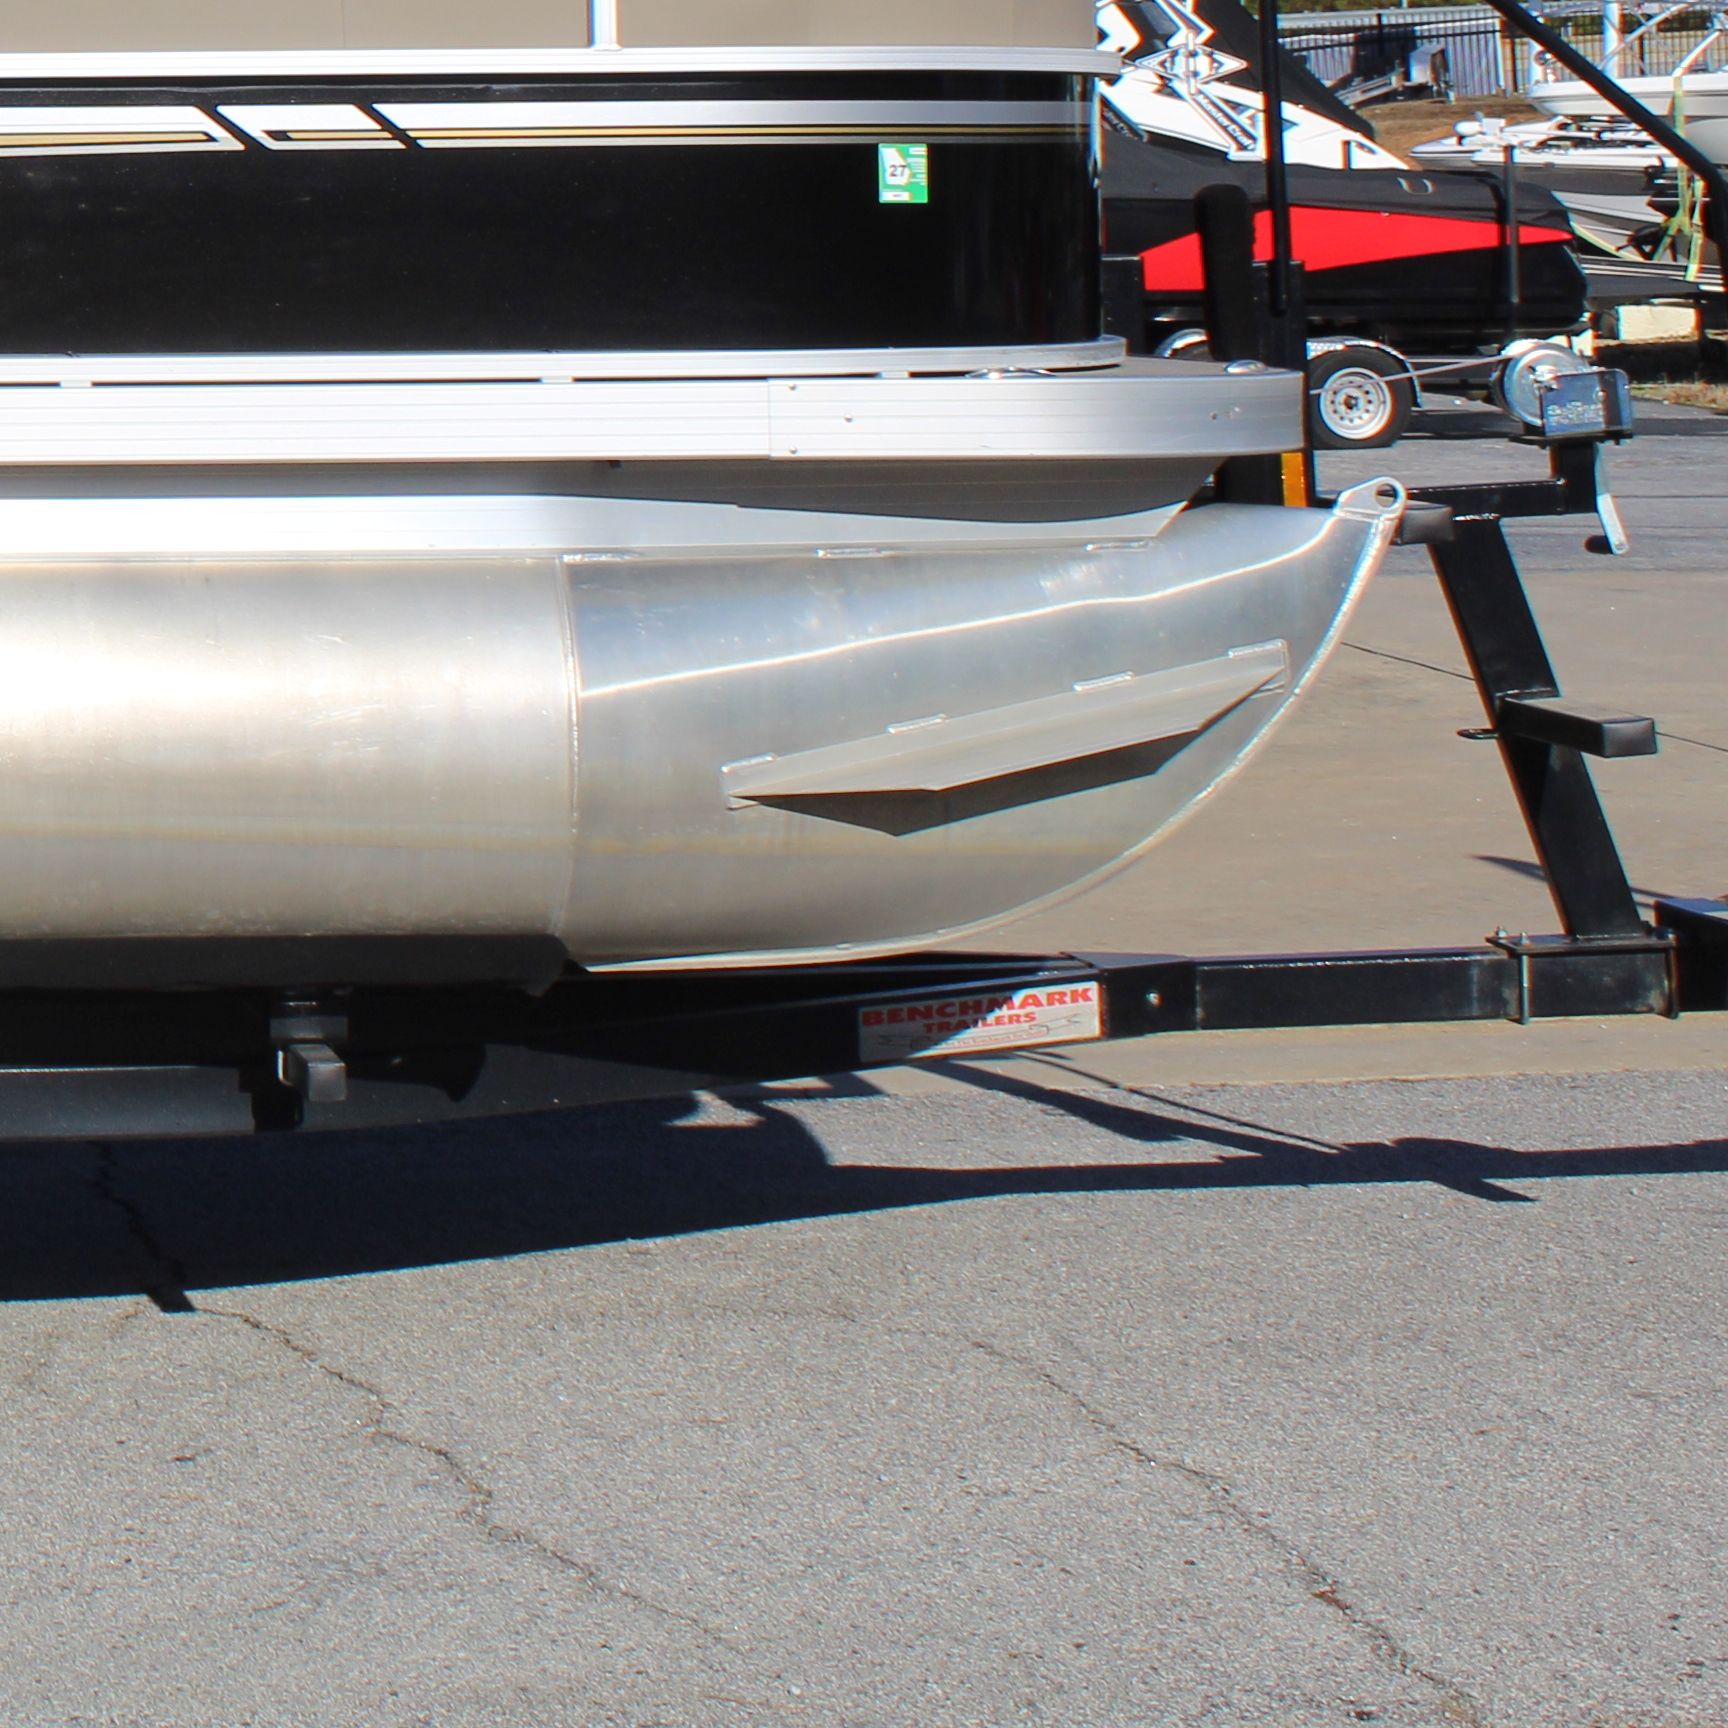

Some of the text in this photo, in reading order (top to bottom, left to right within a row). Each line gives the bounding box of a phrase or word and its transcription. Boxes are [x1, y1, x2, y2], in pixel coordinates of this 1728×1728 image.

[888, 163, 908, 178] 27
[861, 986, 1094, 1028] BENCHMARK
[923, 1011, 1038, 1035] TRAILERS
